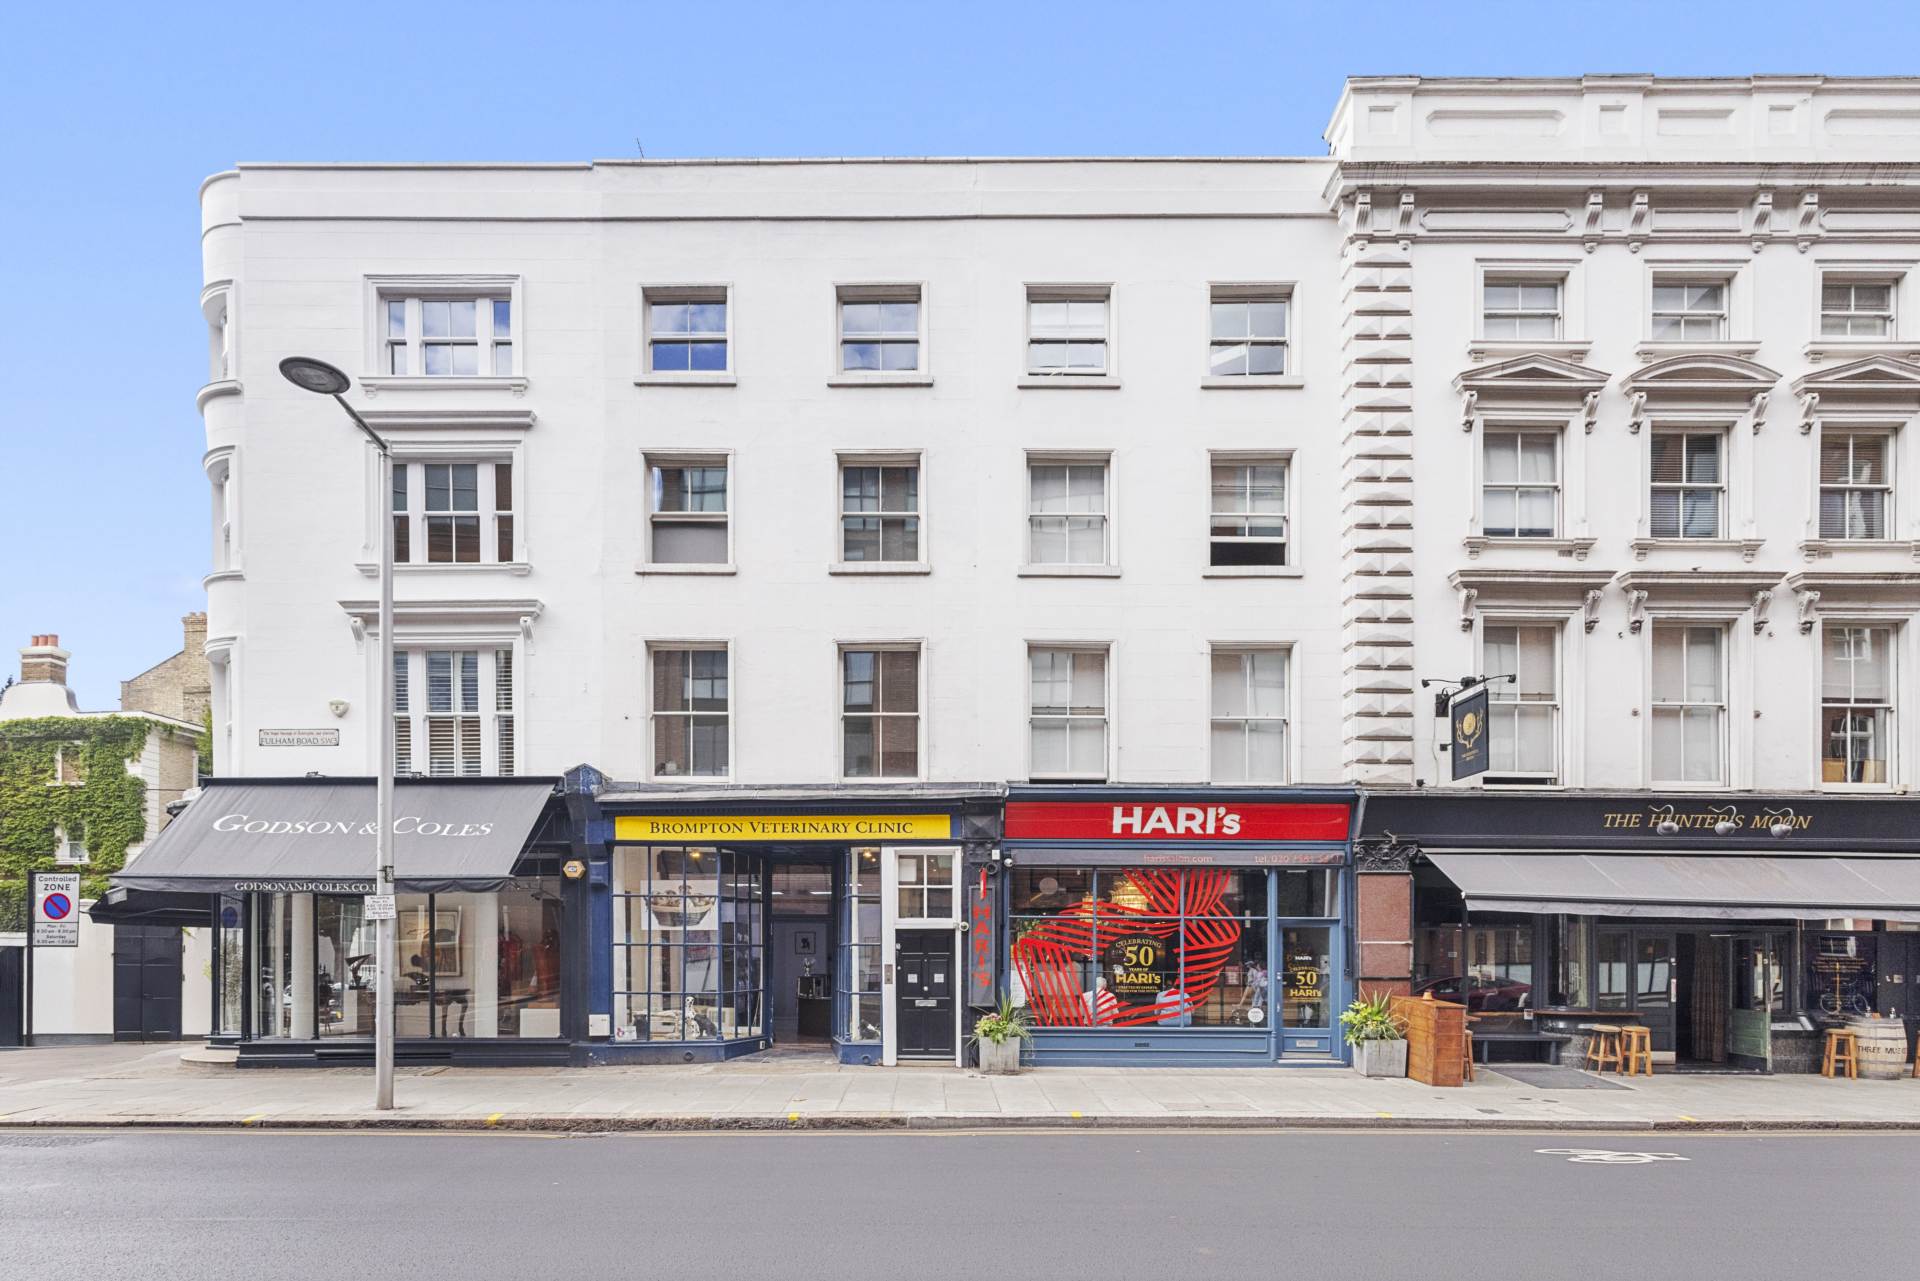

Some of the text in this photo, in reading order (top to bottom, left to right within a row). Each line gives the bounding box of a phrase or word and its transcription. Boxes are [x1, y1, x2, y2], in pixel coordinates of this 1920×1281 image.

[1111, 806, 1241, 835] HARI's
[1603, 813, 1642, 828] THE
[1749, 815, 1814, 829] MOON
[43, 883, 71, 891] ZONE
[234, 882, 378, 893] GODSONANDCOLES.CO.
[1116, 939, 1161, 949] CELEBRATING
[1124, 945, 1154, 966] 50
[1116, 974, 1161, 983] HARI's
[1295, 971, 1317, 985] 50
[1289, 988, 1323, 997] HARI's
